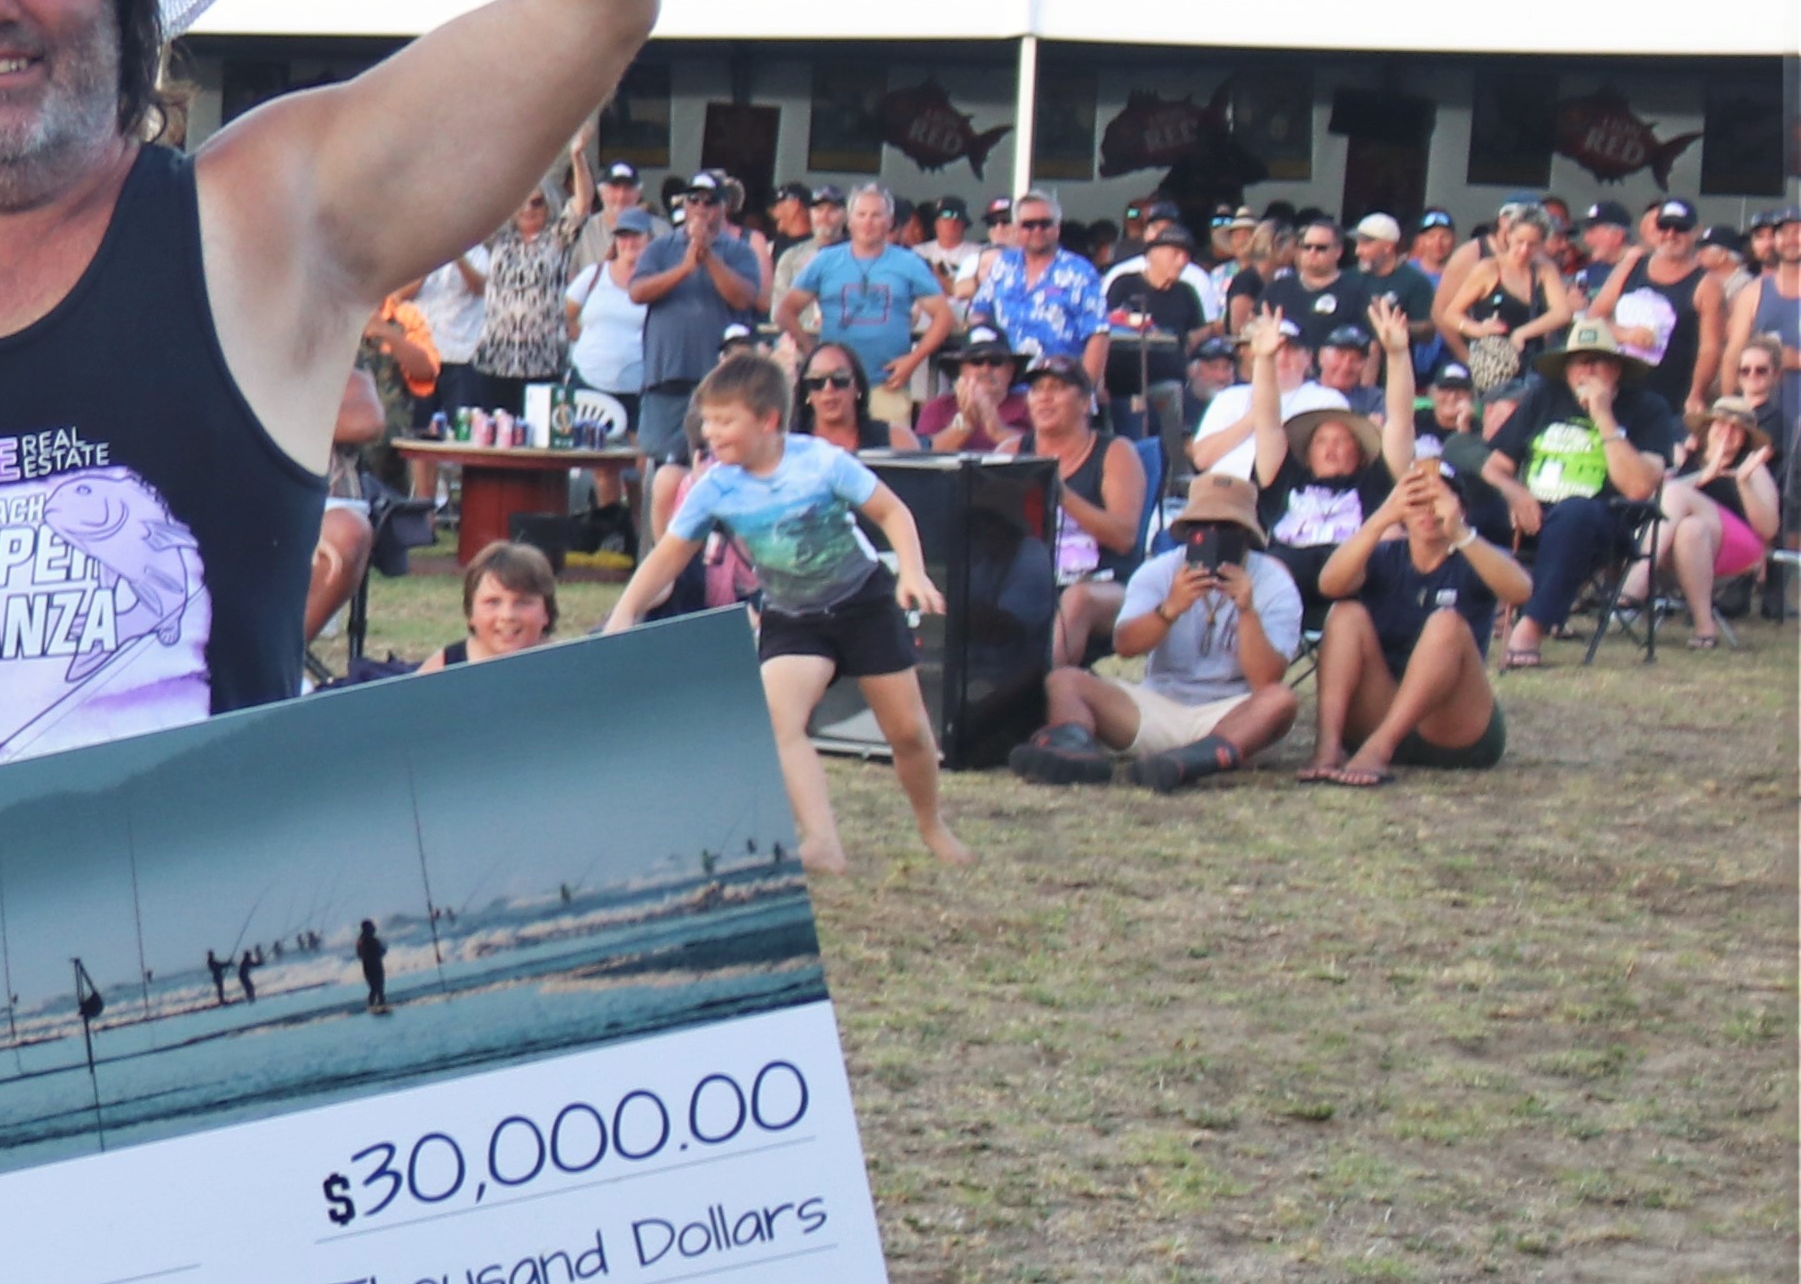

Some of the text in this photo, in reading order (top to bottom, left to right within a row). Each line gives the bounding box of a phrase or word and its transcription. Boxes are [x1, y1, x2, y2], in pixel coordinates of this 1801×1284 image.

[1583, 125, 1646, 166] RED
[22, 426, 86, 457] REAL
[24, 442, 110, 478] ESTATE
[322, 1060, 811, 1228] $30,000.00
[631, 1194, 829, 1268] Dollars
